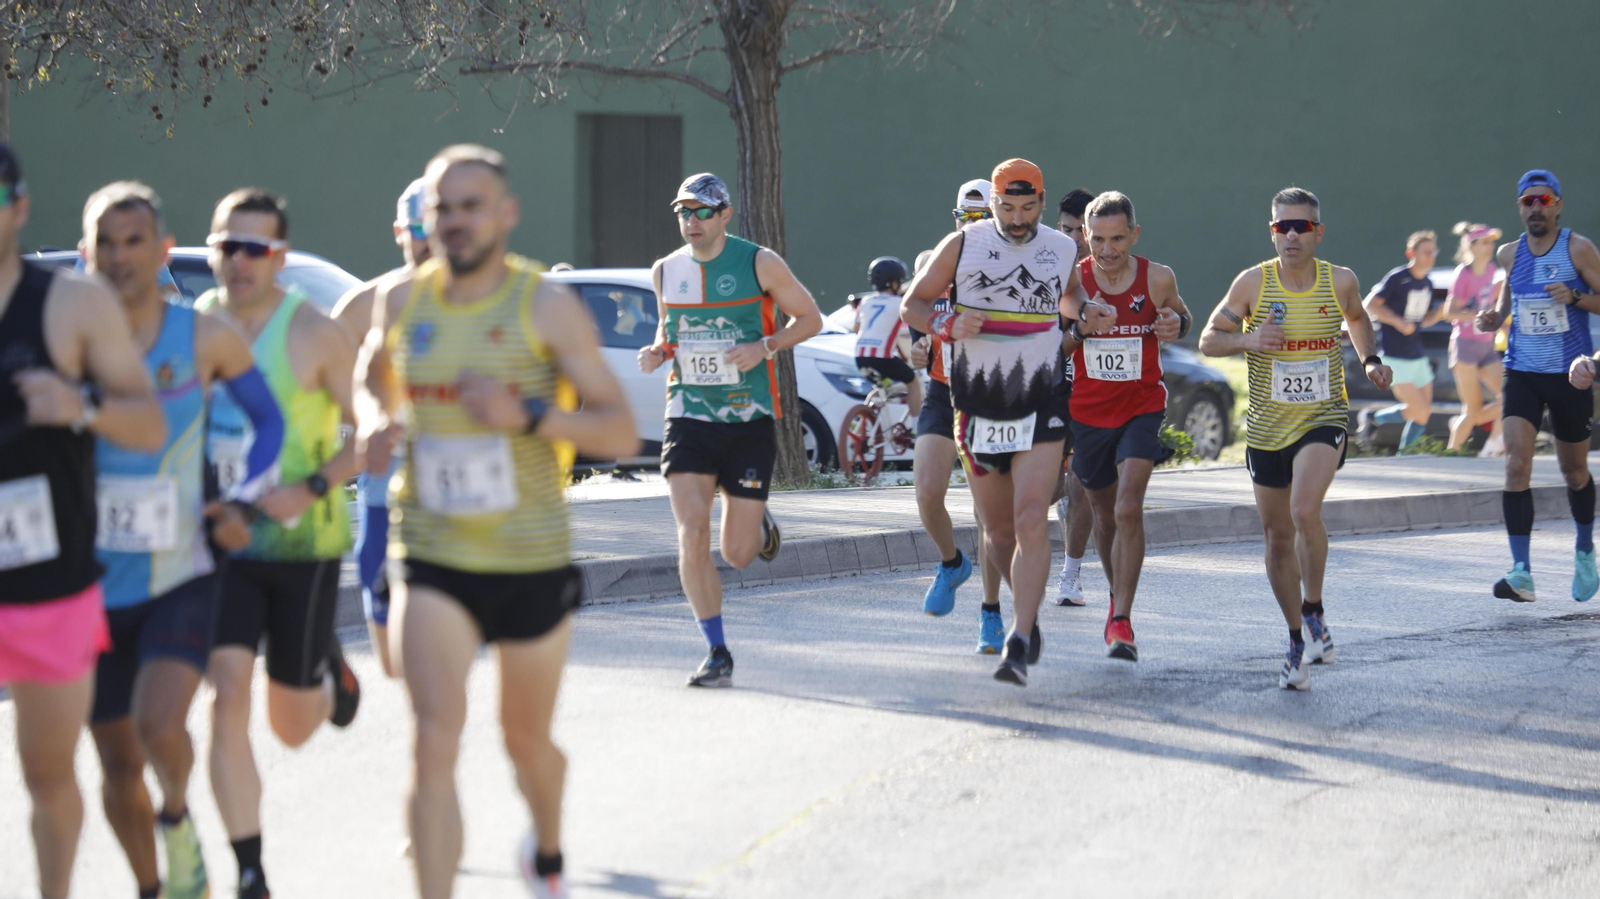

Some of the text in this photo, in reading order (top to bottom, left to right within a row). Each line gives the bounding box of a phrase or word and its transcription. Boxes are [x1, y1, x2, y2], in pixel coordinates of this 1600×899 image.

[867, 304, 886, 330] 7
[1530, 312, 1548, 326] 76
[691, 357, 718, 374] 165
[1096, 354, 1125, 371] 102
[1283, 376, 1313, 393] 232
[986, 426, 1017, 443] 210
